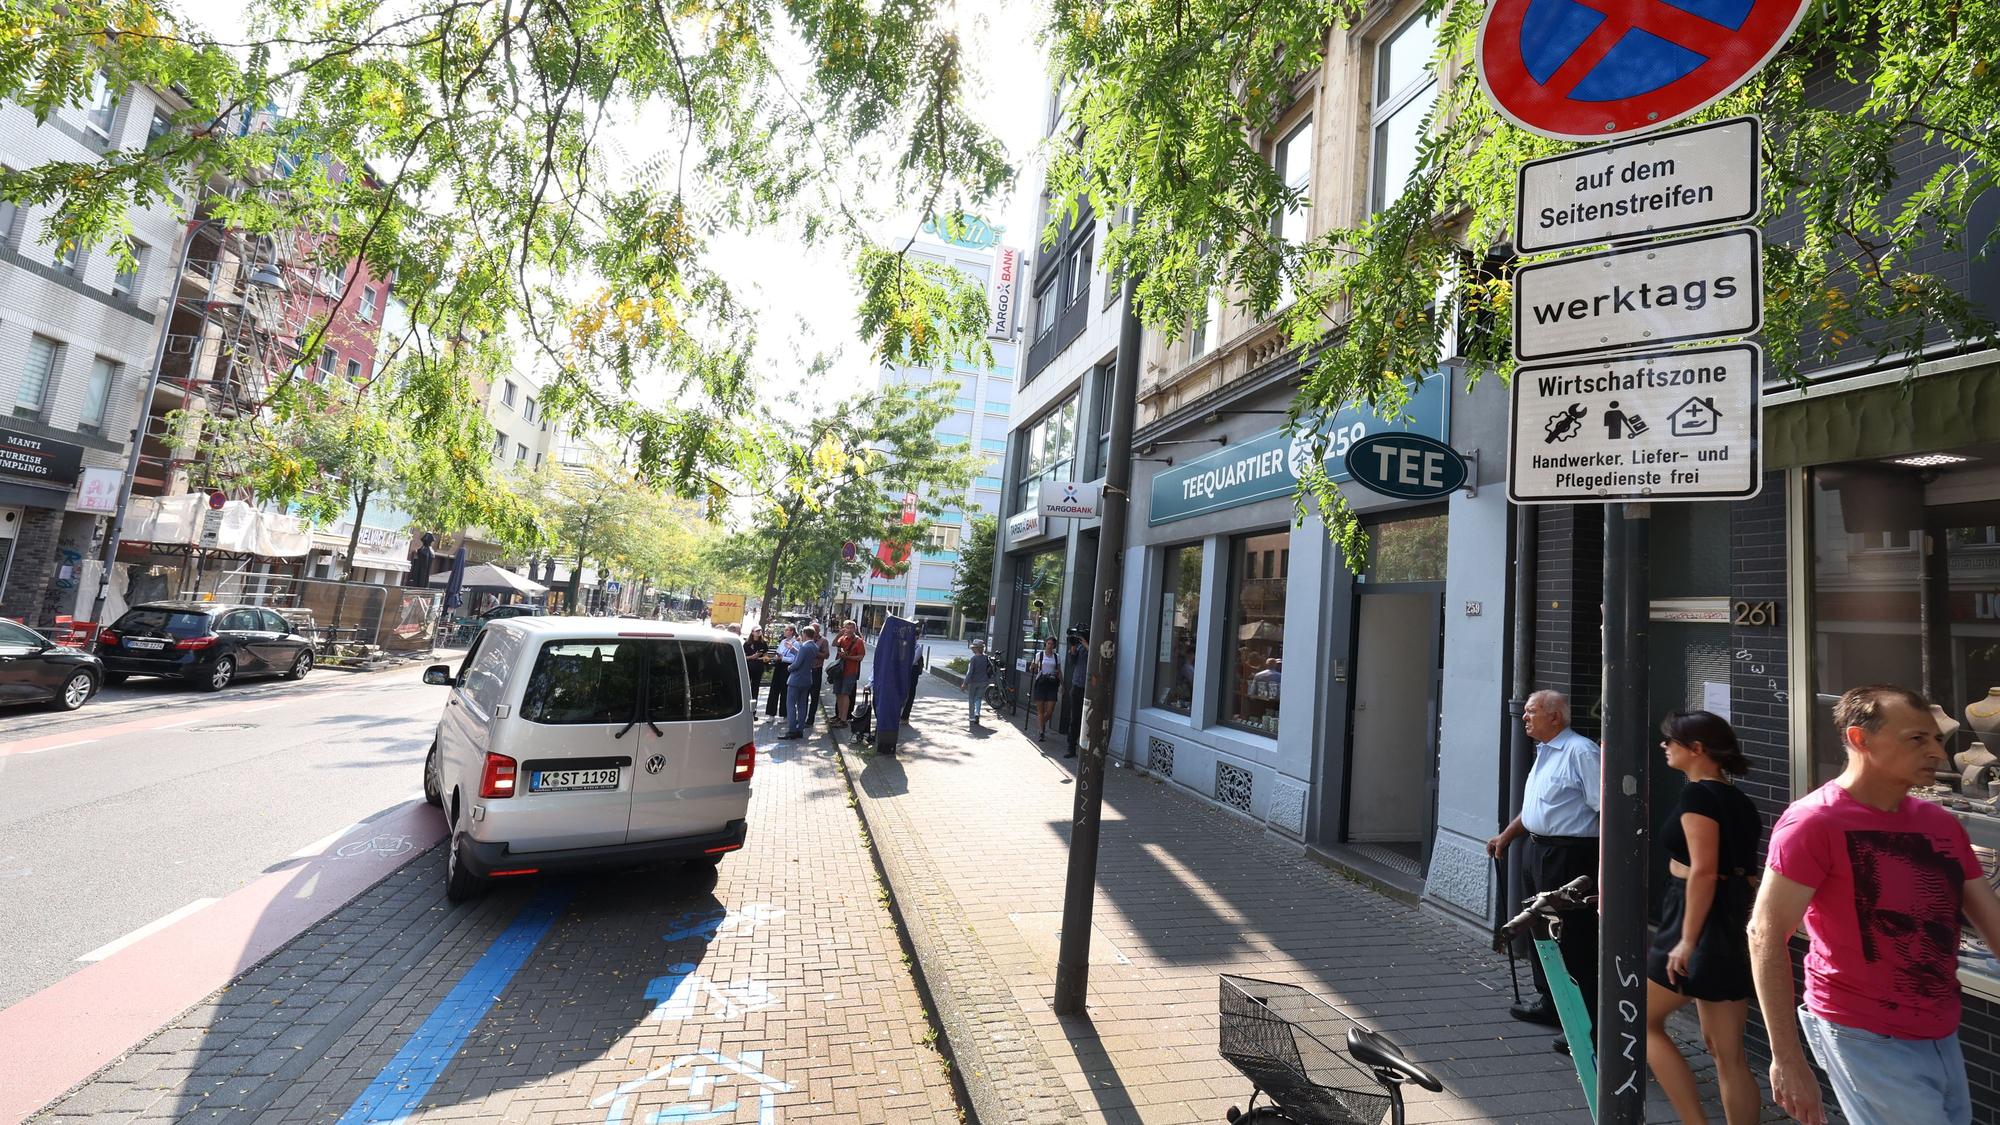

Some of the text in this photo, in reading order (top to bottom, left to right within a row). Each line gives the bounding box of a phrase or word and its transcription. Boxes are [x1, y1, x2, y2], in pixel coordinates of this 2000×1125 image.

[1575, 159, 1675, 192] auf dem
[1539, 184, 1714, 229] Seitenstreifen
[1533, 275, 1738, 326] werktags
[1538, 365, 1727, 398] Wirtschaftszone
[0, 449, 42, 465] TURKISH
[7, 436, 42, 450] MANTI
[1632, 448, 1689, 465] Liefer-
[1697, 445, 1729, 462] und
[1182, 448, 1284, 500] TEEQUARTIER
[1372, 444, 1446, 488] TEE
[1556, 468, 1700, 490] Pflegedienste frei
[1046, 504, 1093, 514] TARGOBANK
[1466, 602, 1480, 614] 259
[1734, 601, 1777, 626] 261
[541, 772, 552, 786] K
[581, 770, 616, 784] 1198
[1076, 761, 1090, 827] SONY
[1614, 955, 1640, 1096] SONY
